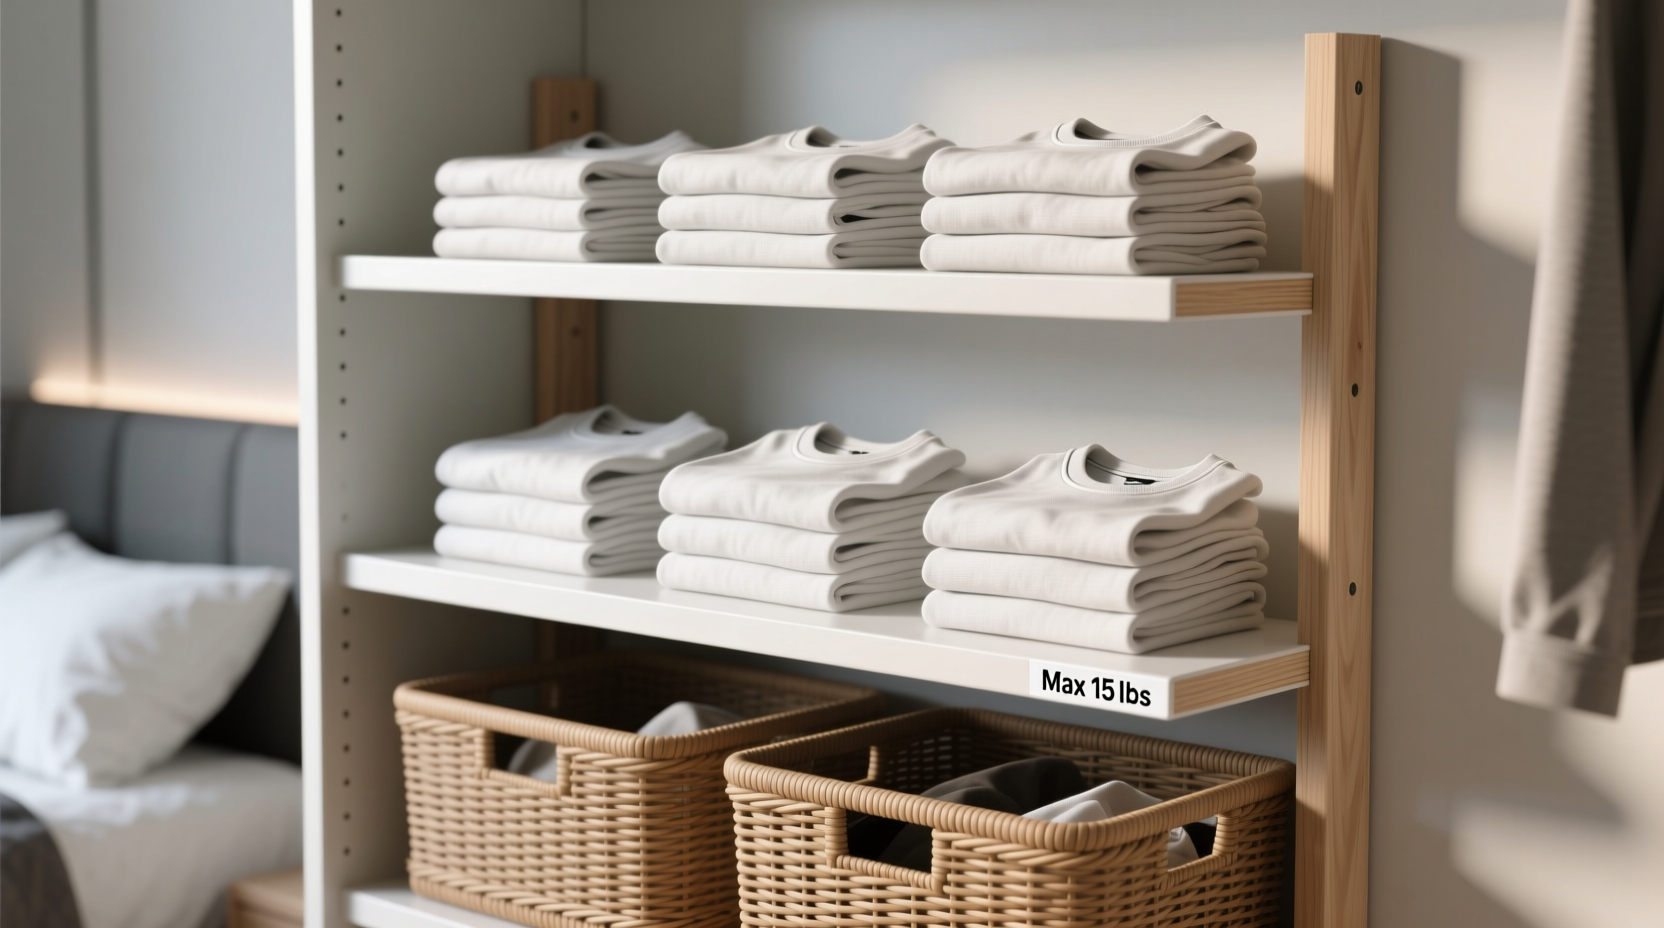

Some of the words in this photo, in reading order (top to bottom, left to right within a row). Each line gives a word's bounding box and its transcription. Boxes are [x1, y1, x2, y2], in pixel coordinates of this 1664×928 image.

[1042, 669, 1086, 697] Max
[1091, 677, 1115, 701] 15
[1119, 680, 1151, 707] lbs
